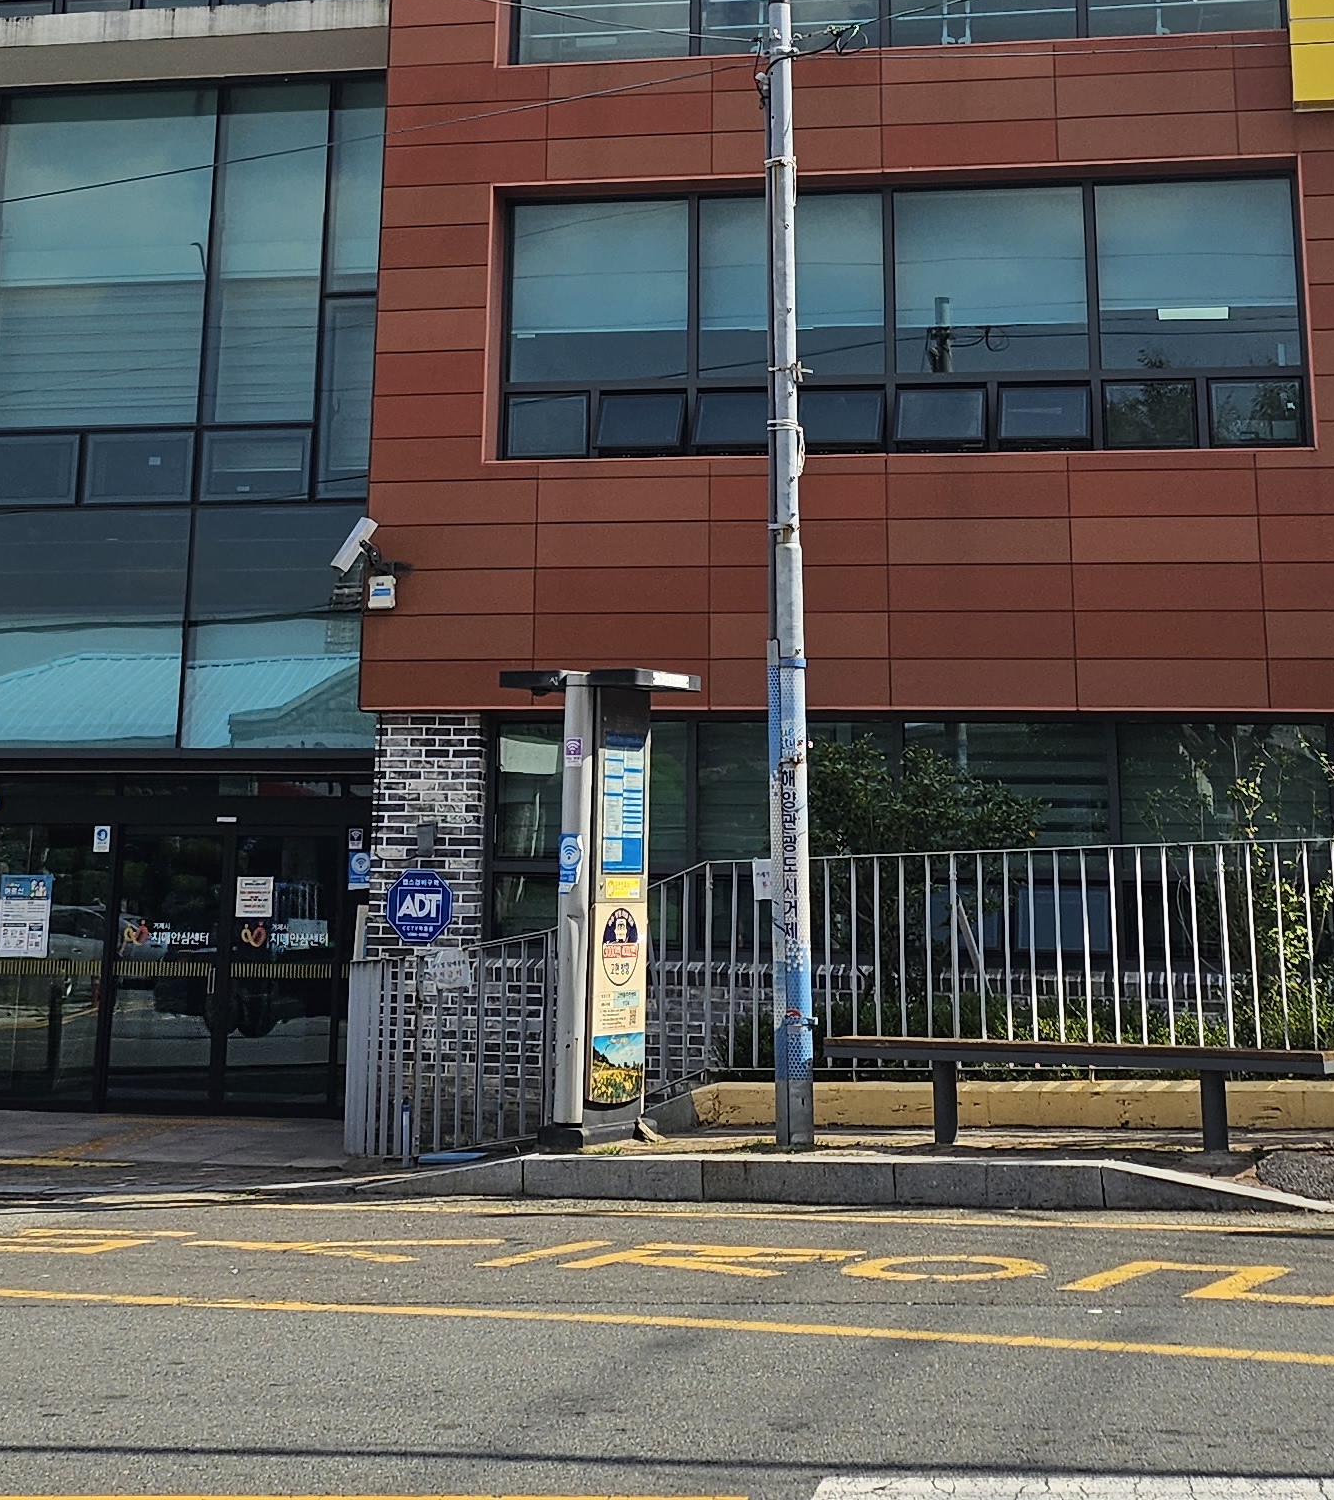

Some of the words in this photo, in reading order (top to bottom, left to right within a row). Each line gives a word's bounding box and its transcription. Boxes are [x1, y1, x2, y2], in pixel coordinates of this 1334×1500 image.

[398, 893, 441, 918] ADT
[152, 922, 171, 931] 거제시
[271, 923, 289, 931] 거제시
[150, 932, 210, 945] 치매안심센터
[269, 932, 329, 947] 치매안심센터
